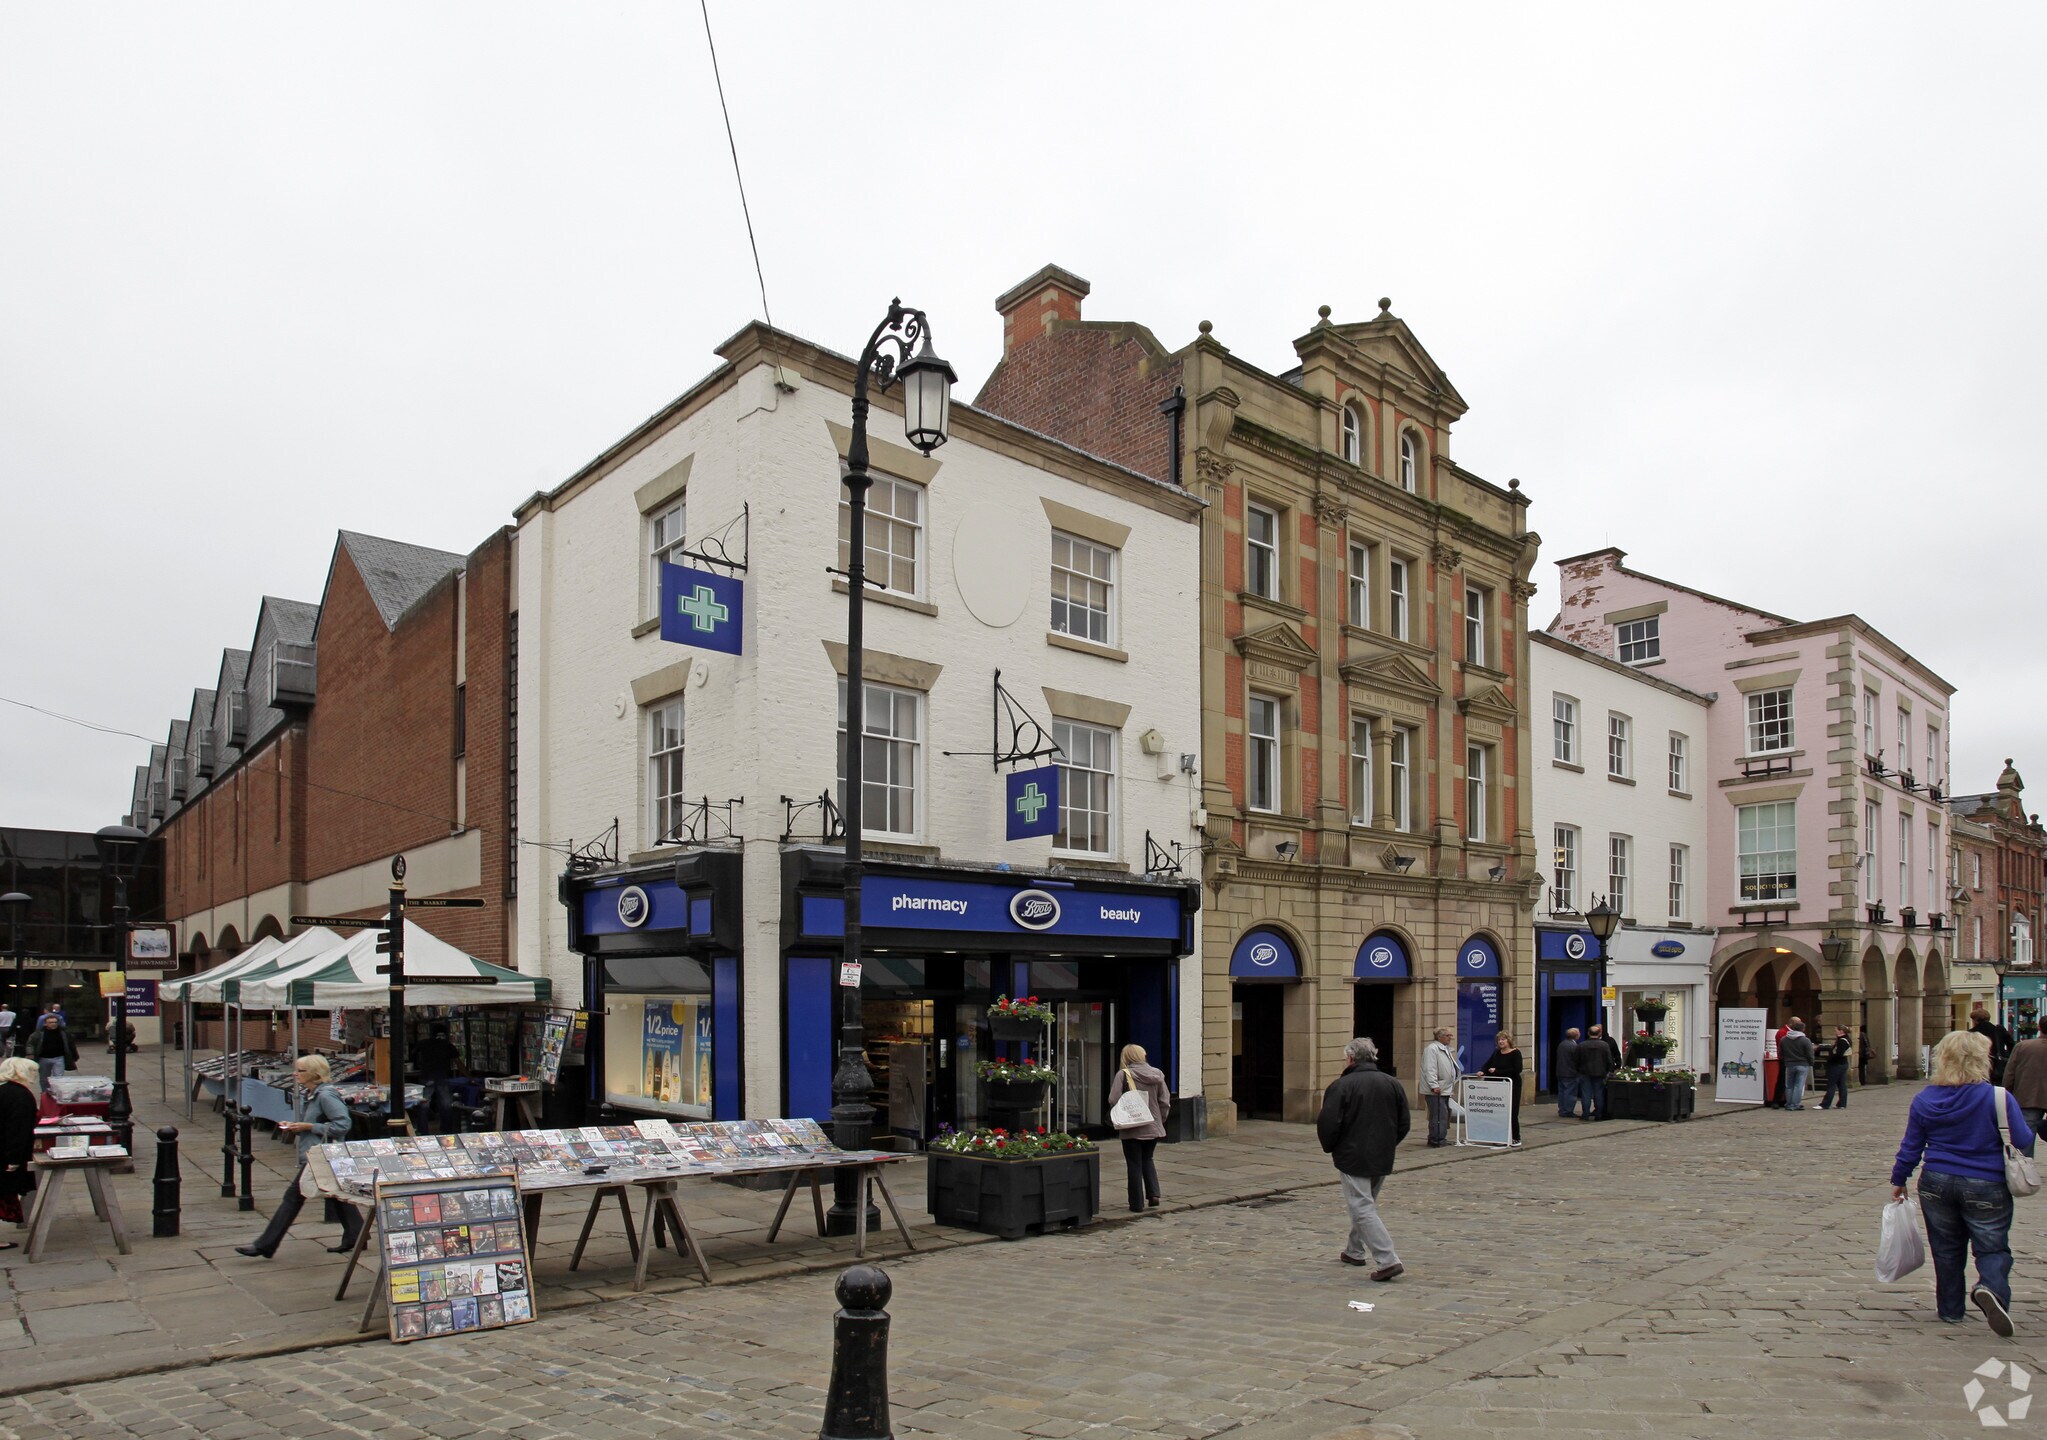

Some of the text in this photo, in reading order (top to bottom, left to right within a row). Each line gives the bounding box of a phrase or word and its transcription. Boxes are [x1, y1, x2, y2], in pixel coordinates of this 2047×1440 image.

[1744, 882, 1789, 891] SOLICITORS
[621, 897, 639, 915] Boots
[892, 893, 1141, 924] pharmacy Boots beauty
[646, 1014, 679, 1037] 1/2 price
[1668, 1010, 1679, 1035] Laser
